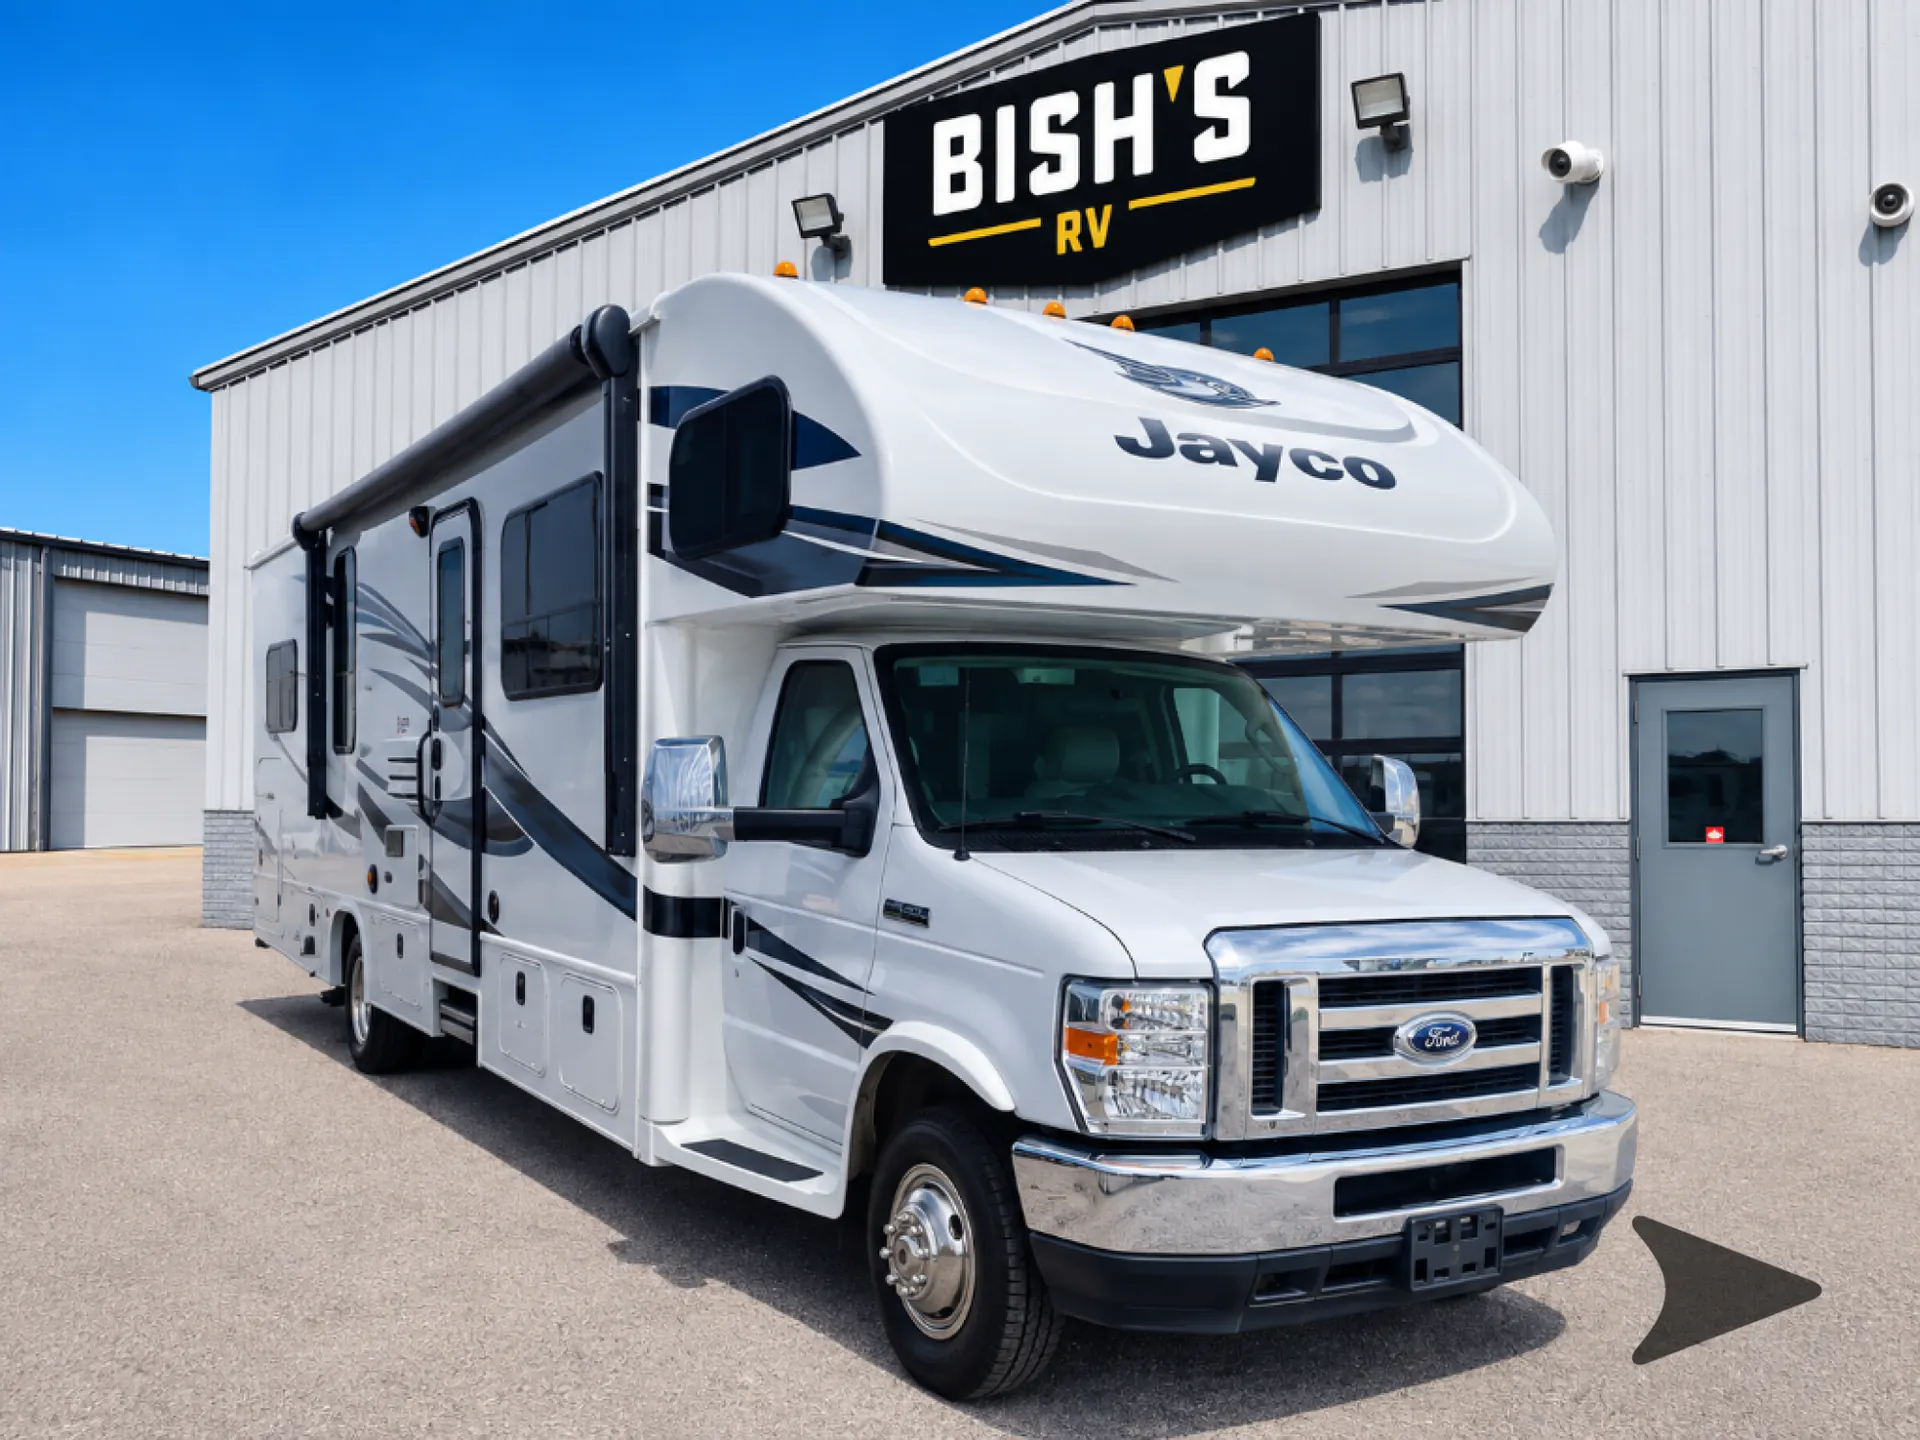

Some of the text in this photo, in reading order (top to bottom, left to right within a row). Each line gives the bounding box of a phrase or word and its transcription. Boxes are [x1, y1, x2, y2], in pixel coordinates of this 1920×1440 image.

[933, 51, 1250, 216] BISH'S
[1056, 204, 1112, 255] RV
[1113, 416, 1397, 490] Jayco
[1424, 1026, 1460, 1048] Ford
